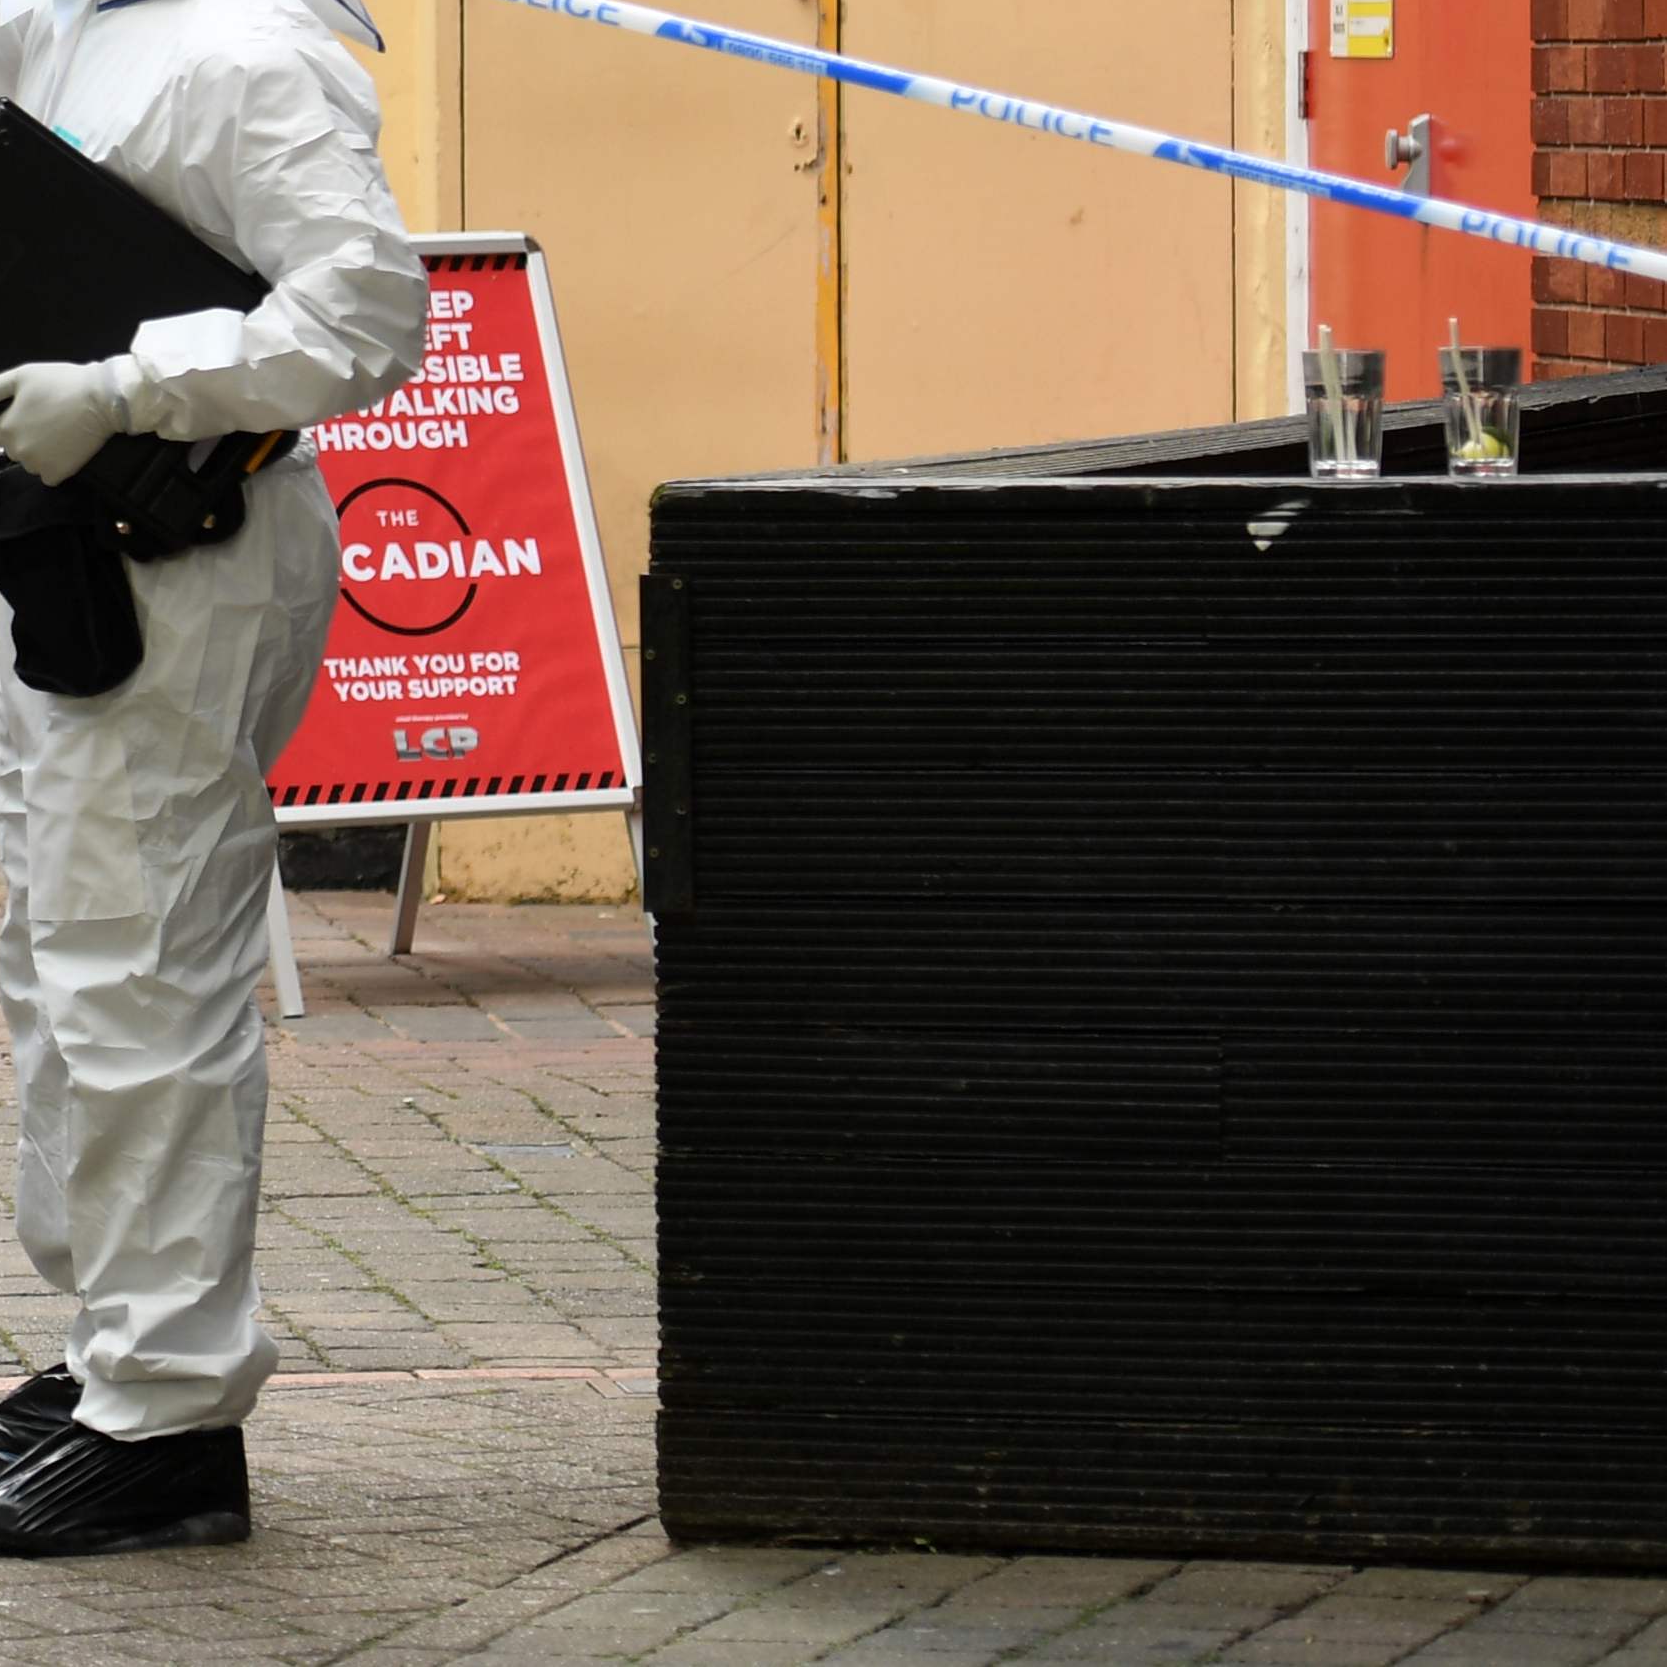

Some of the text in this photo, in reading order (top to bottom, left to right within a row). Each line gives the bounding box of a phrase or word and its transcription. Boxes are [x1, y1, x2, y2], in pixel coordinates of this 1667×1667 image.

[427, 290, 474, 318] EP
[424, 322, 472, 352] FT
[376, 509, 419, 527] THE
[323, 651, 521, 679] THANK YOU FOR
[333, 675, 518, 702] YOUR SUPPORT
[393, 726, 479, 762] LCP
